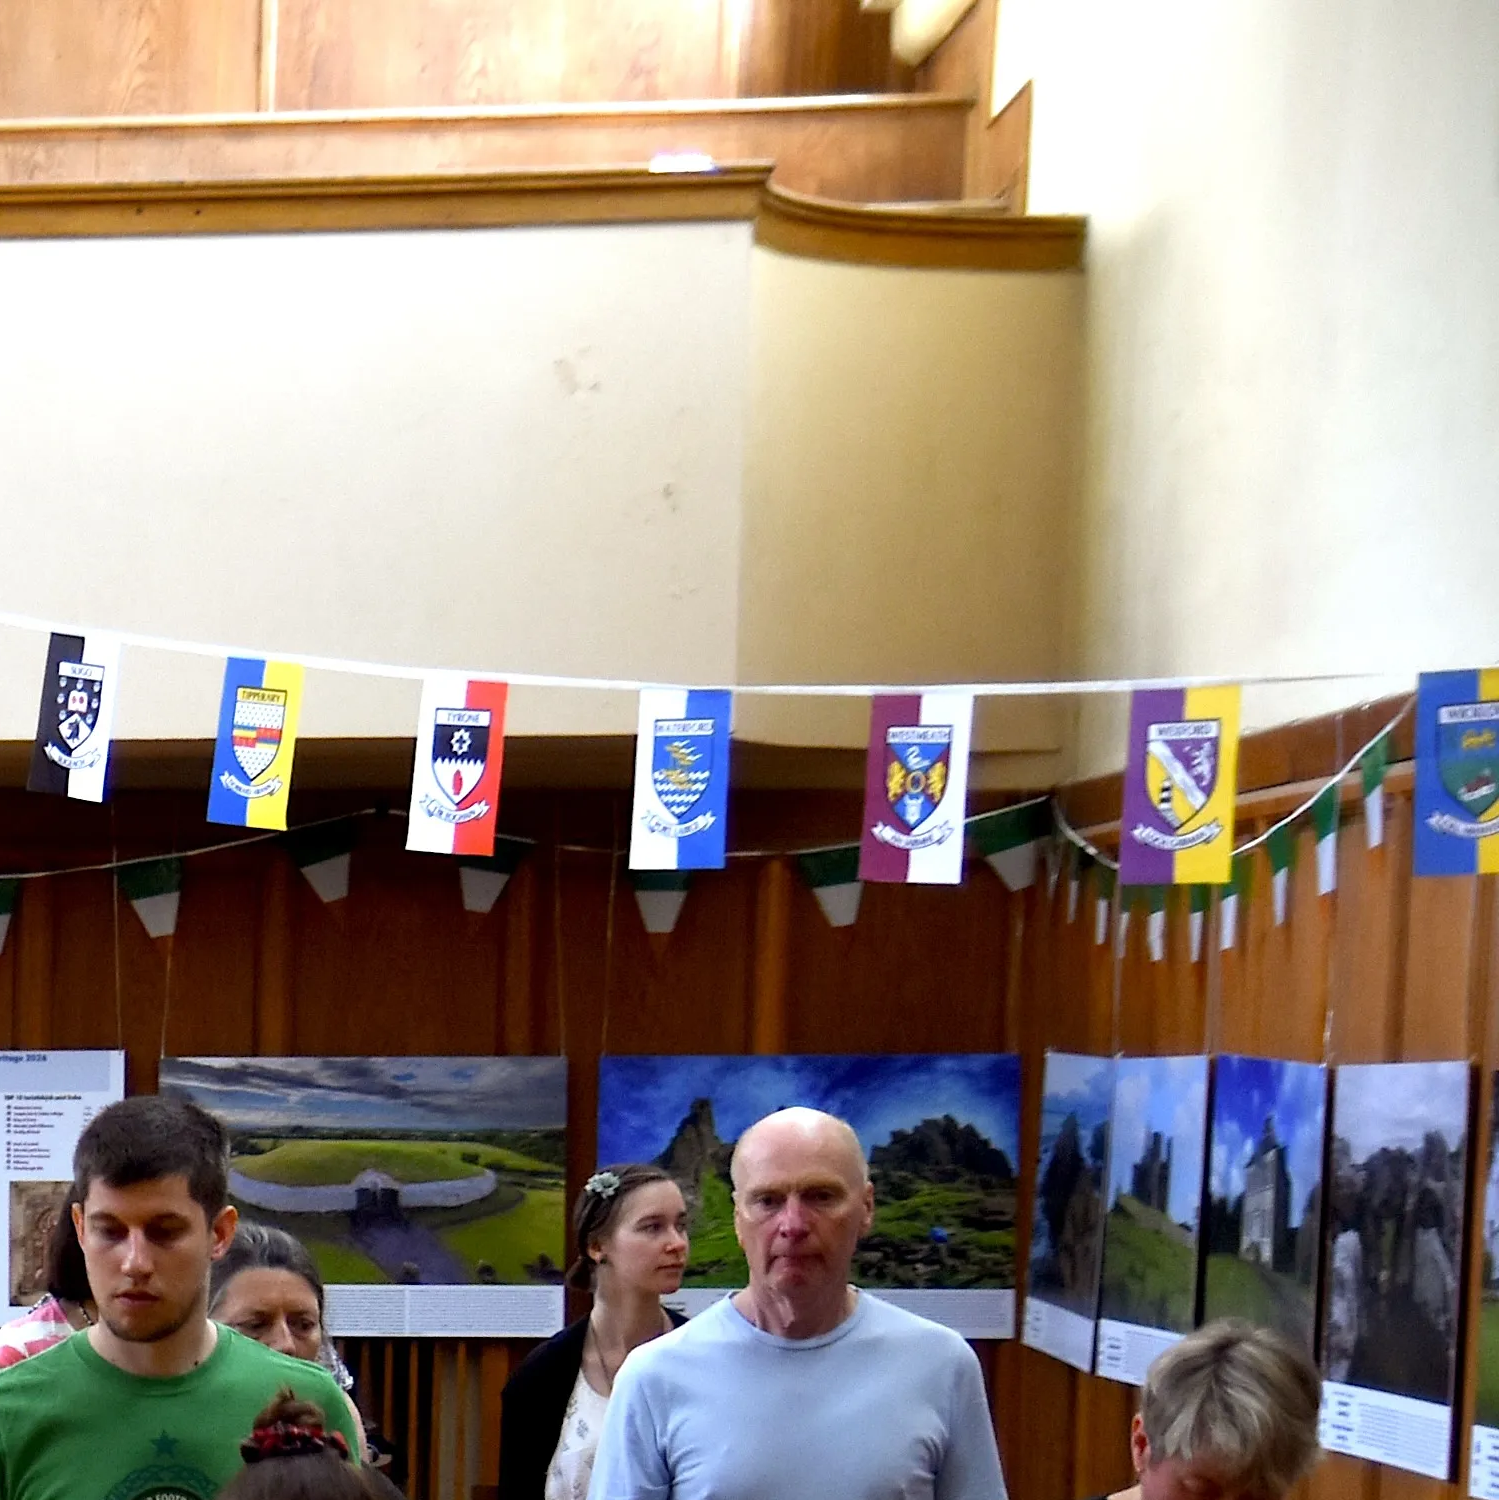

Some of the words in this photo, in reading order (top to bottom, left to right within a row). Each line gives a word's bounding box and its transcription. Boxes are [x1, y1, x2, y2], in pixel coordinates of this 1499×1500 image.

[70, 665, 93, 677] SLIGO
[240, 689, 281, 703] TIPPERARY
[447, 711, 481, 724] TYRONE
